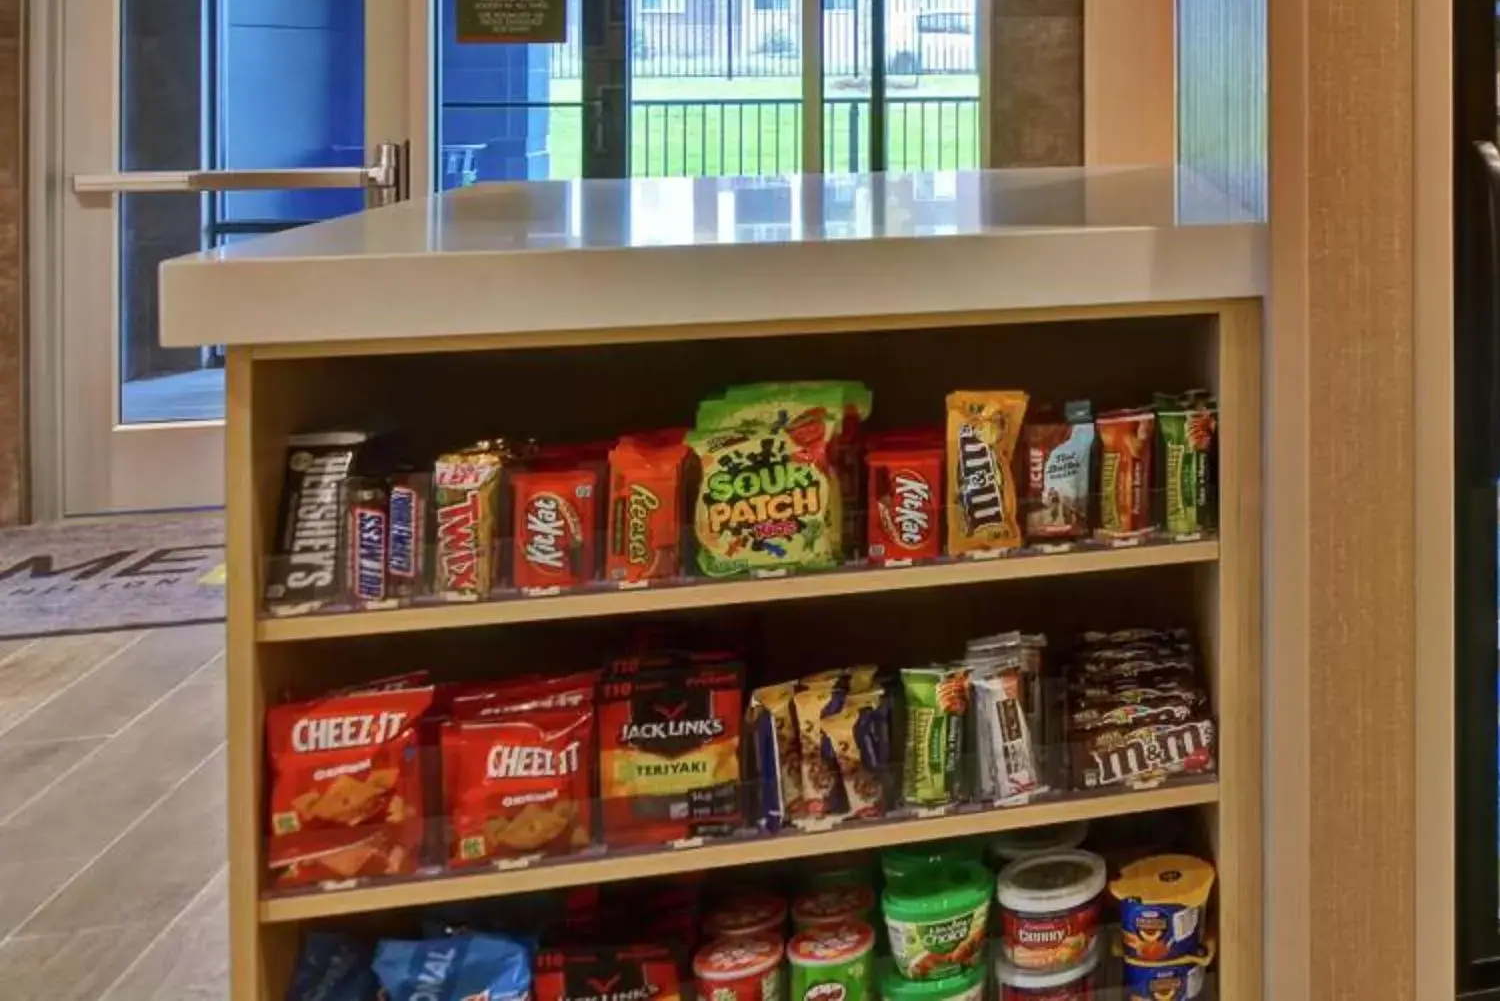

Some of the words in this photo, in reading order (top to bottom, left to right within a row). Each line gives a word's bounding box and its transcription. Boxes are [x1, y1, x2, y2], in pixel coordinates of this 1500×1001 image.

[707, 463, 813, 501] SOUR
[287, 451, 353, 589] HERSHEY'S
[629, 485, 660, 565] Reese's
[706, 487, 821, 531] PATCH
[620, 722, 668, 741] JACK
[635, 760, 707, 777] TERIYAKI
